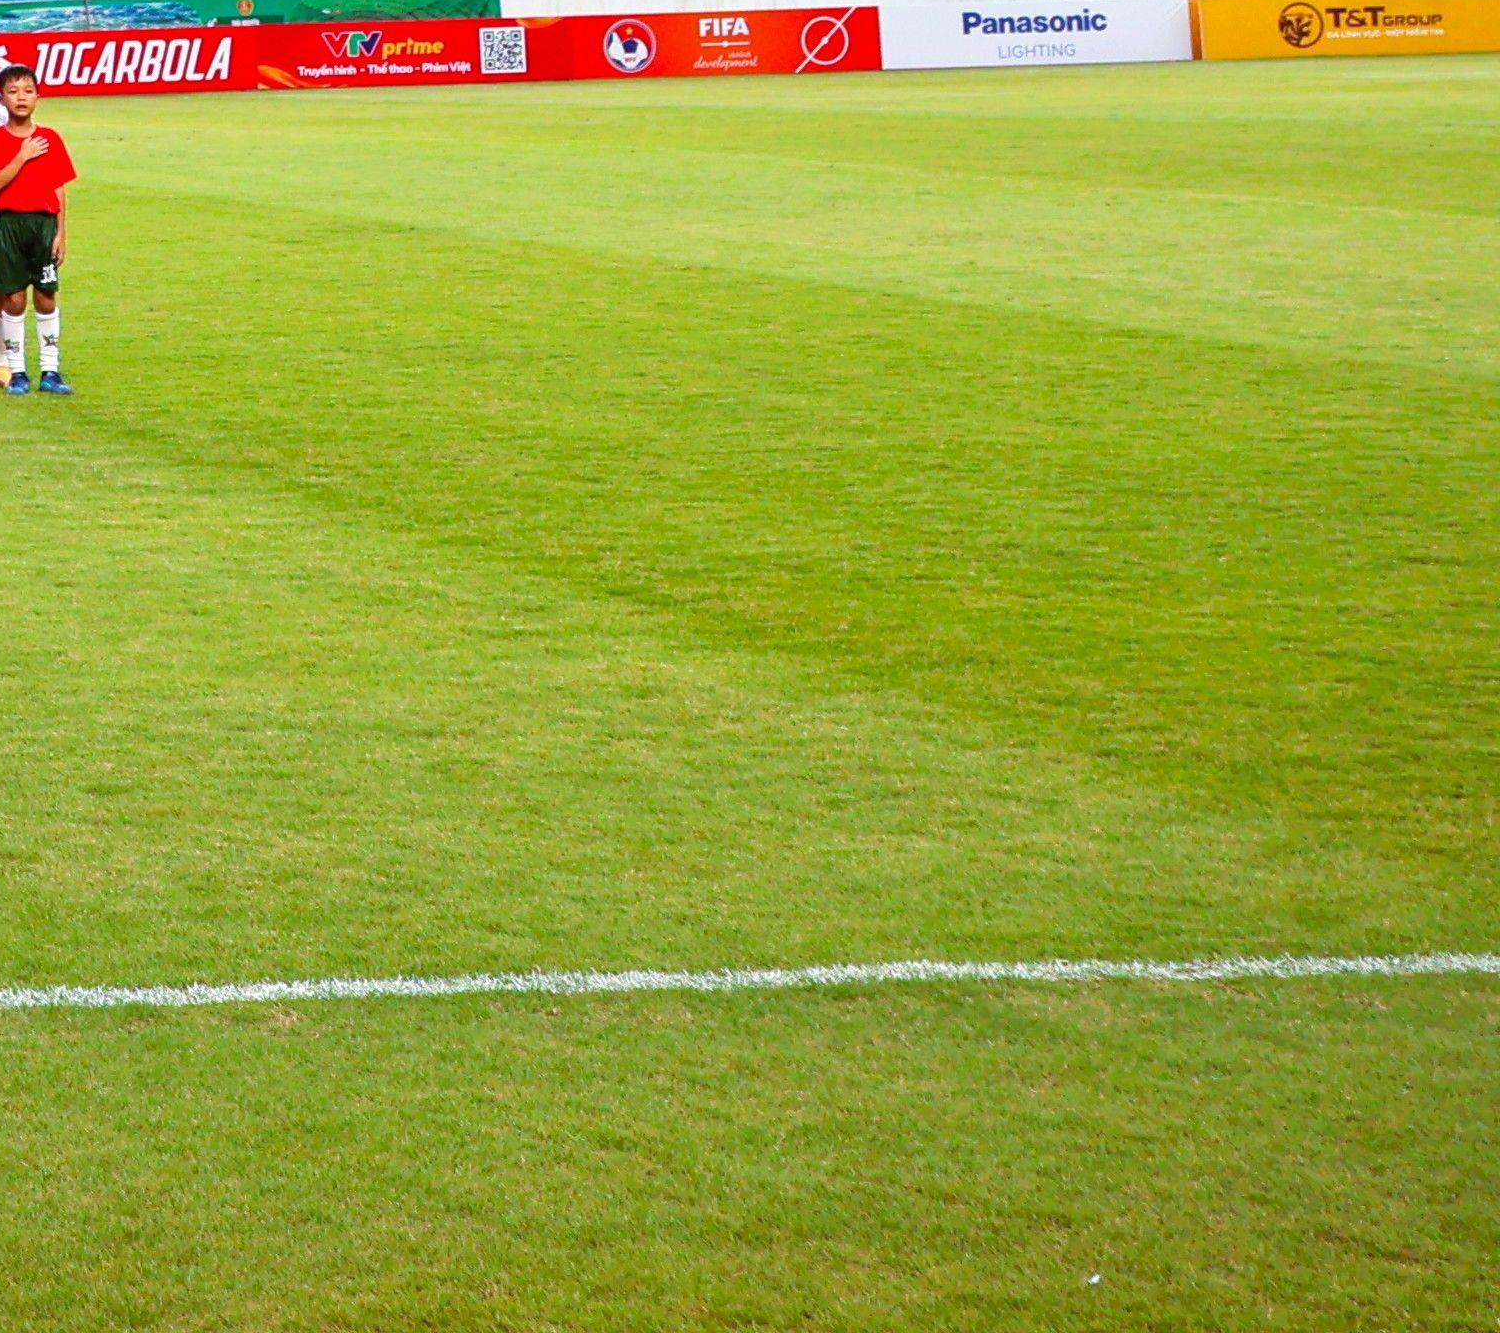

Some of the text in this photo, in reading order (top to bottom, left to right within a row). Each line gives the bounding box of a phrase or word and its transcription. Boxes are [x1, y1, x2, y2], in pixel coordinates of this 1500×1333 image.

[699, 17, 749, 37] FIFA
[962, 8, 1107, 35] Panasonic
[1326, 6, 1443, 28] T&T GROUP
[321, 31, 444, 60] VTV prime
[998, 43, 1076, 59] LIGHTING
[35, 37, 232, 85] JOGARBOLA
[422, 62, 447, 74] Phim
